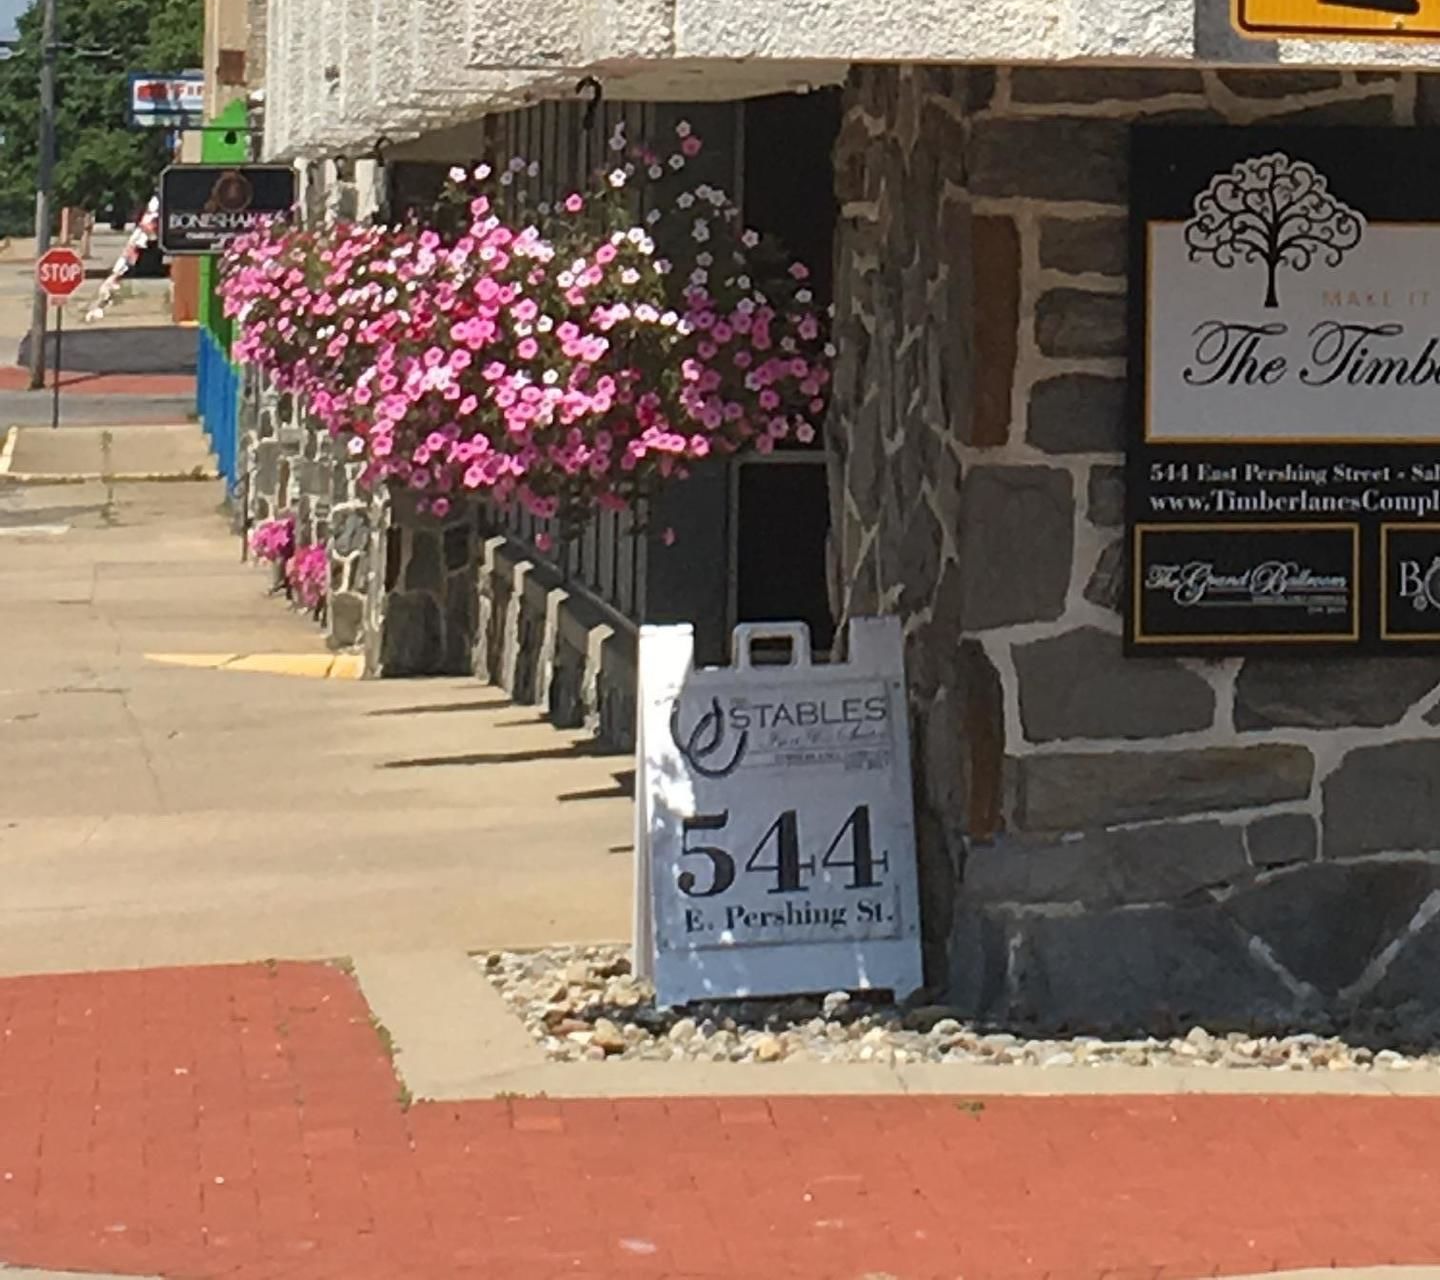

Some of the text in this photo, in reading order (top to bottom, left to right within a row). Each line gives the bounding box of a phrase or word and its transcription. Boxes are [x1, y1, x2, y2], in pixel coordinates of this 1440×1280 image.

[40, 263, 81, 282] STOP
[1321, 291, 1392, 308] MAKE
[1408, 291, 1431, 308] IT
[1182, 320, 1287, 387] The
[1150, 464, 1190, 482] 544
[1198, 464, 1238, 482] East
[1245, 463, 1328, 485] Pershing
[1332, 464, 1391, 482] Street
[729, 697, 887, 730] STABLES
[677, 803, 889, 898] 544
[685, 899, 893, 932] E. Pershing St.
